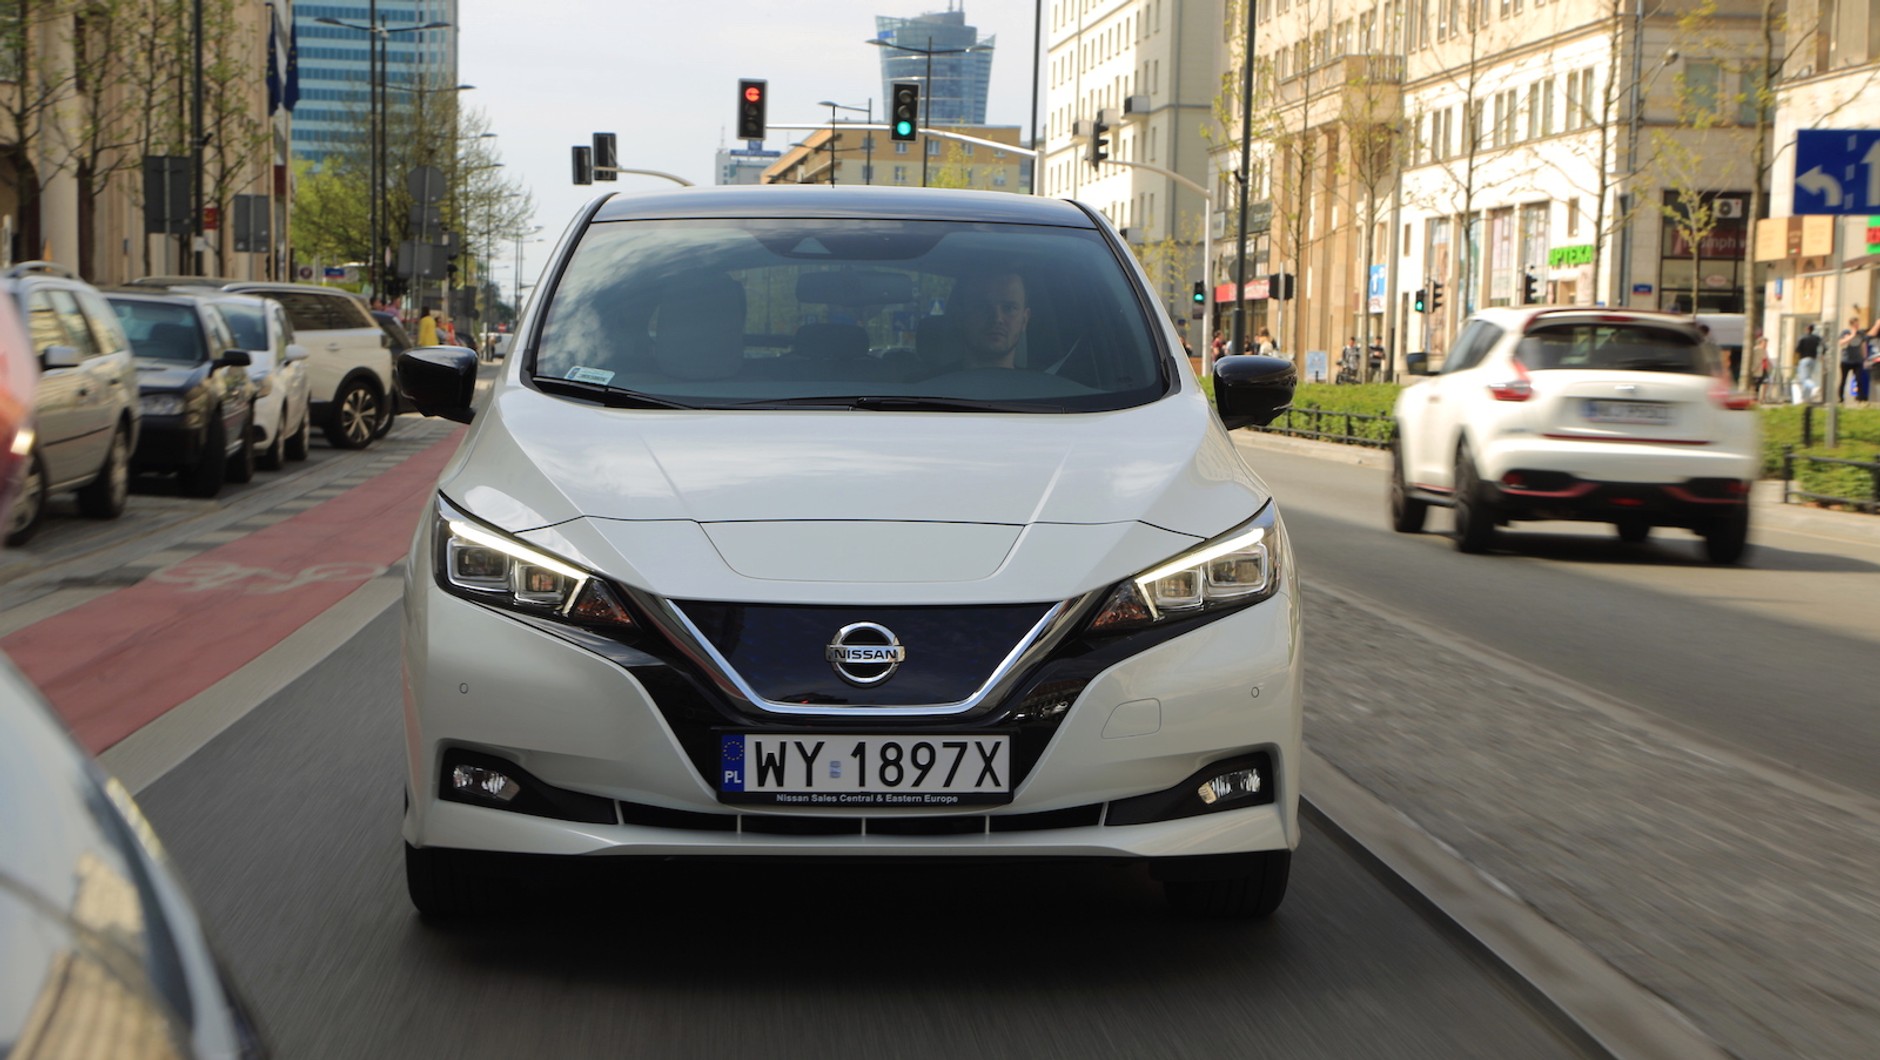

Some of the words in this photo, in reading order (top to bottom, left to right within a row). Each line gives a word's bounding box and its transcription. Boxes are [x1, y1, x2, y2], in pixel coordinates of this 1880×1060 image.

[1548, 245, 1594, 266] APTEKA
[834, 649, 897, 660] NISSAN
[755, 741, 825, 787] WY
[850, 741, 1002, 787] 1897X
[724, 770, 742, 784] PL
[776, 793, 809, 802] Nissan
[811, 794, 838, 803] Sales
[839, 794, 874, 803] Central
[876, 794, 883, 803] &
[886, 794, 921, 803] Eastern
[924, 794, 959, 804] Europe
